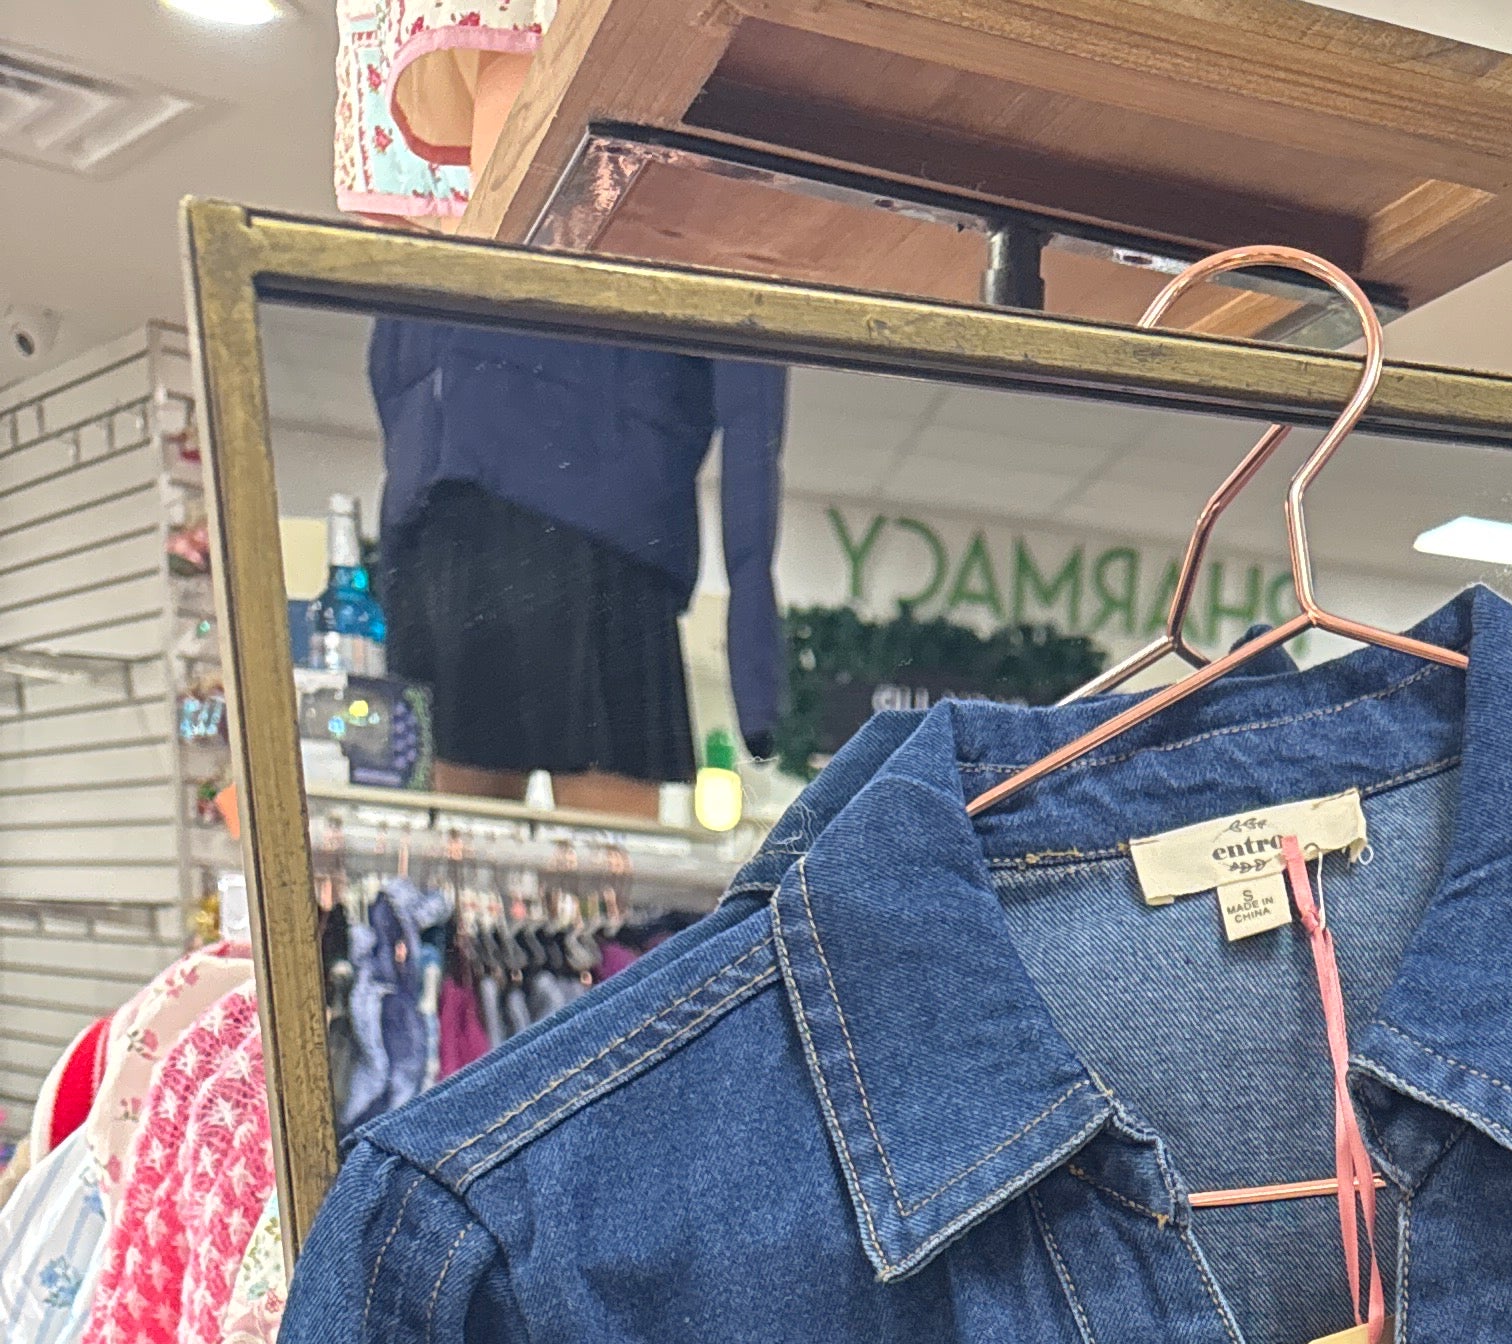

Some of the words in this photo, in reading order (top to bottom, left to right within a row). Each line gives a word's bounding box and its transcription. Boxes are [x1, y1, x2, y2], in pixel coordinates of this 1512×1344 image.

[1242, 889, 1254, 901] S
[1227, 901, 1259, 915] MADE
[1262, 896, 1274, 906] IN
[1235, 908, 1270, 923] CHINA
